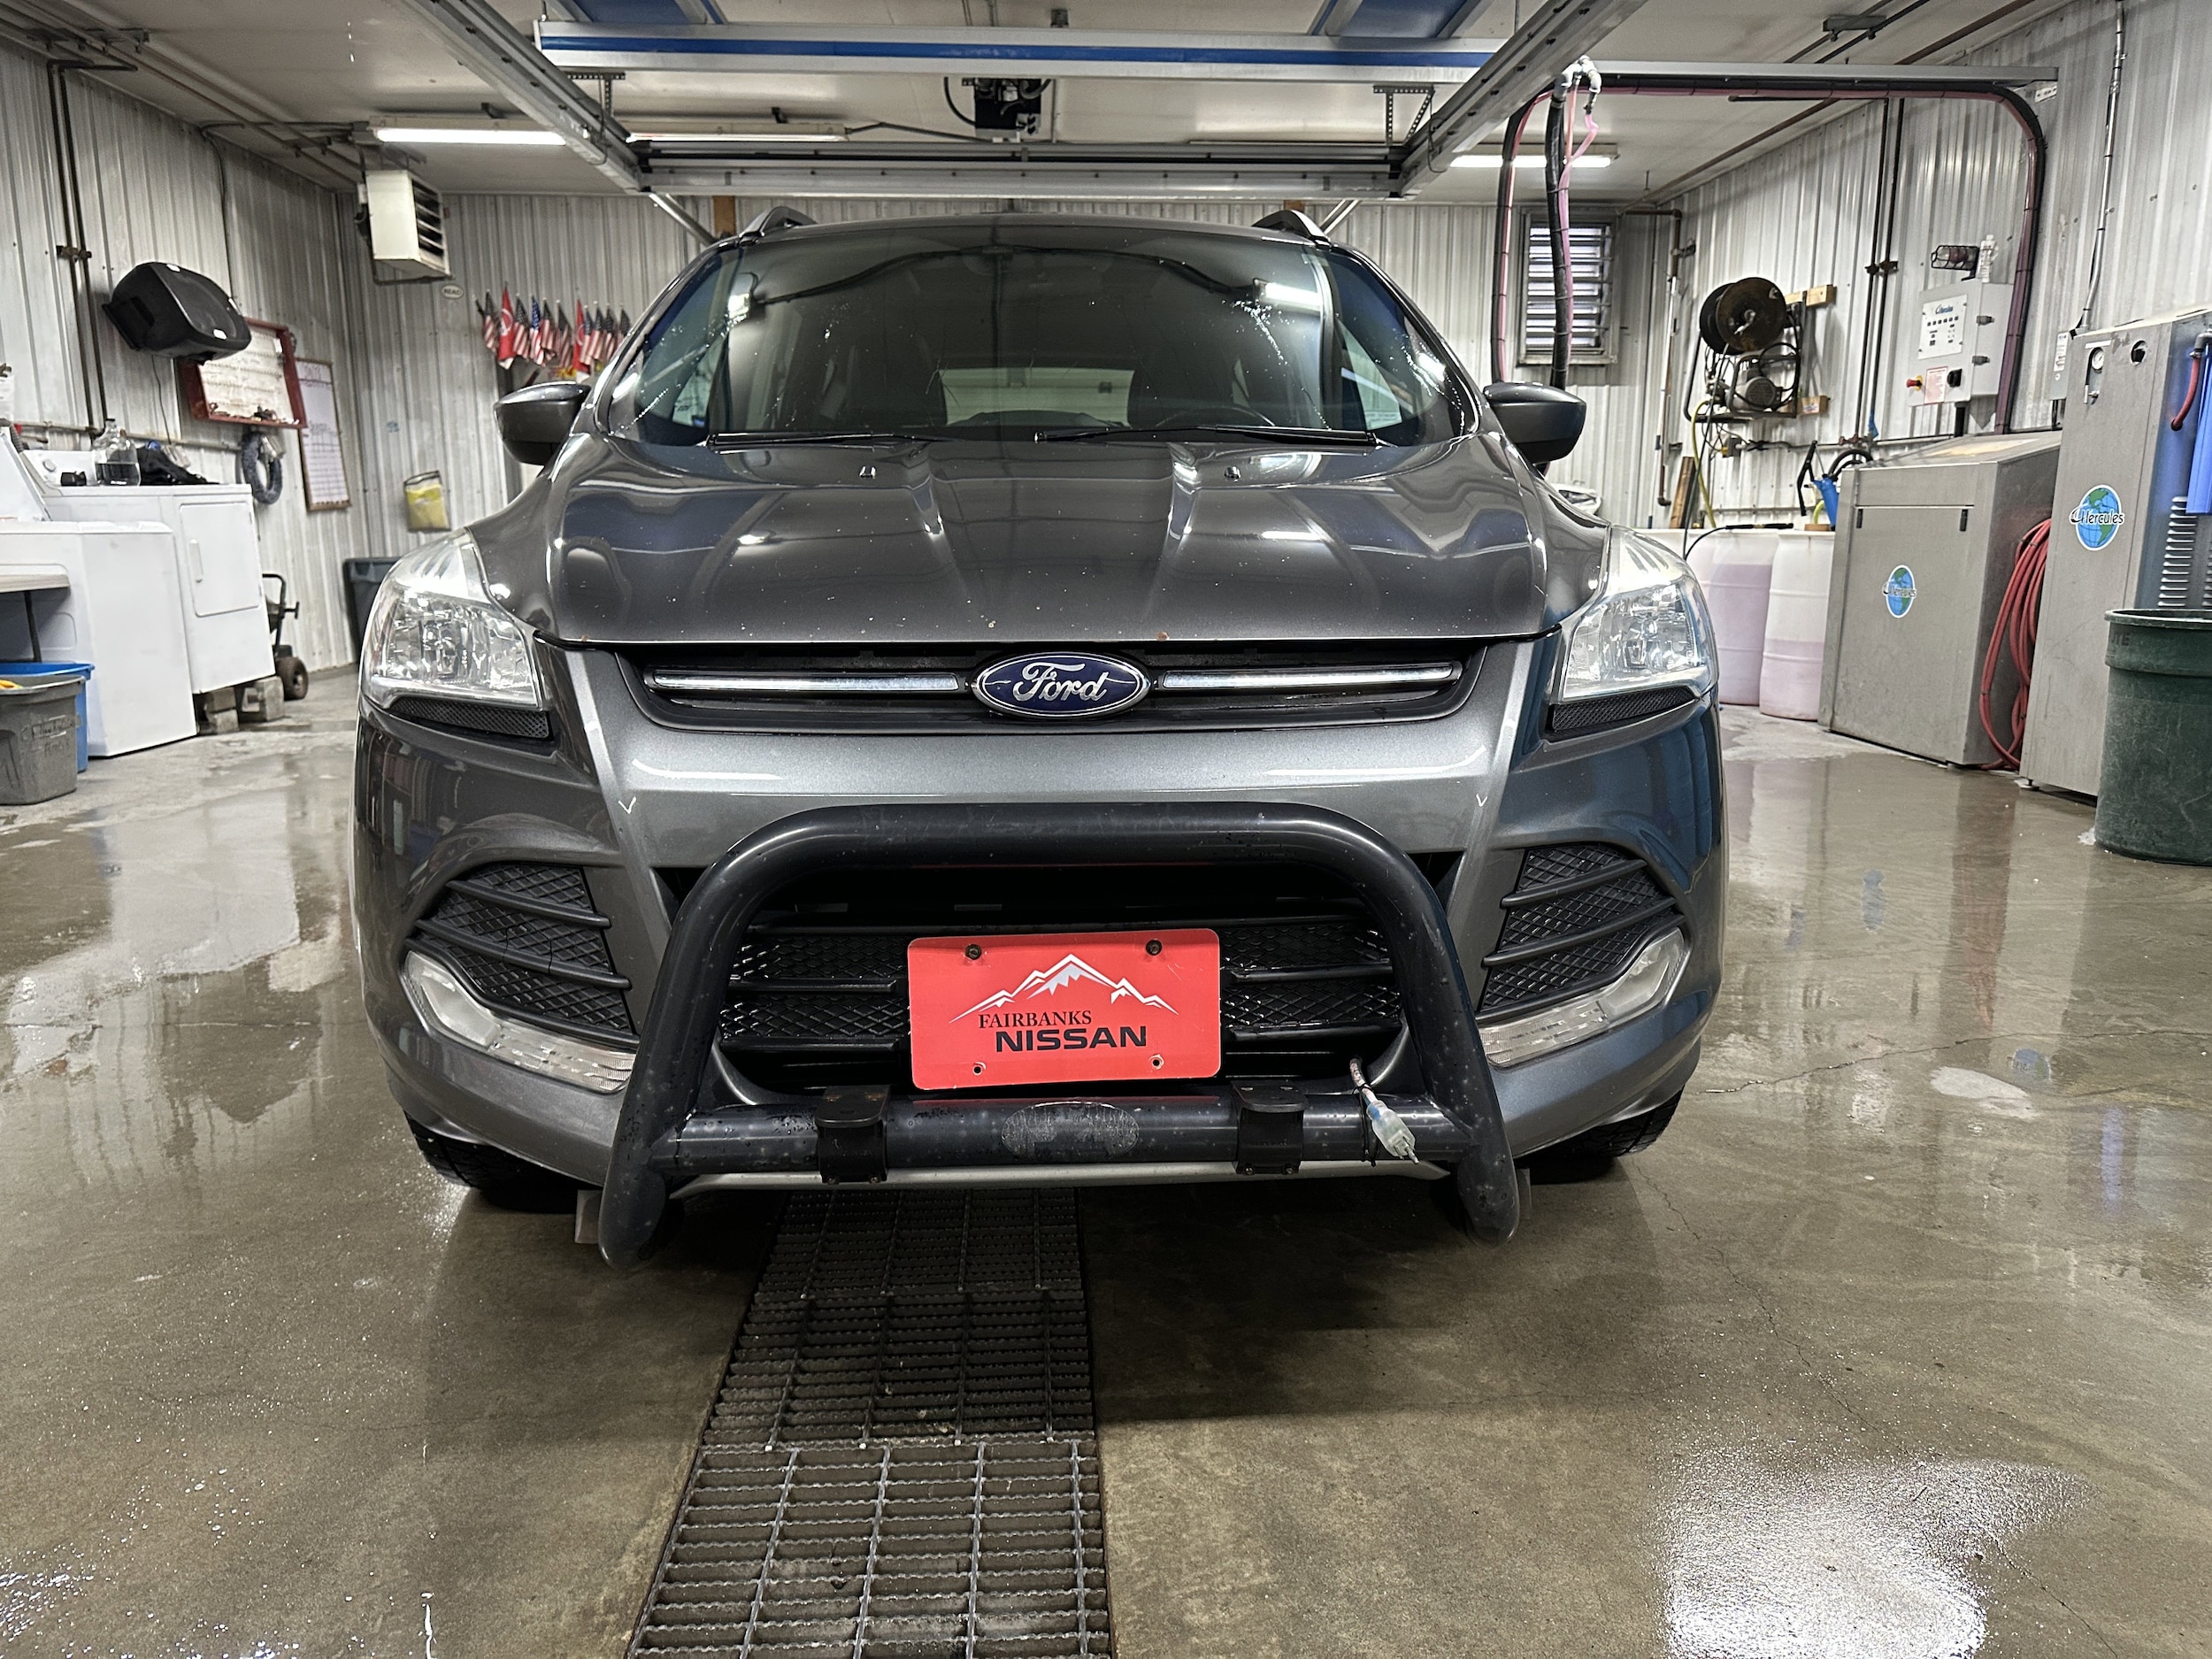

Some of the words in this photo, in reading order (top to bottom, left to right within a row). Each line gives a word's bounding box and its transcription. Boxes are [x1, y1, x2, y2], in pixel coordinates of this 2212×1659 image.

[2070, 509, 2124, 524] Hercules
[1013, 662, 1110, 701] Ford
[979, 1010, 1092, 1029] FAIRBANKS
[996, 1027, 1147, 1052] NISSAN
